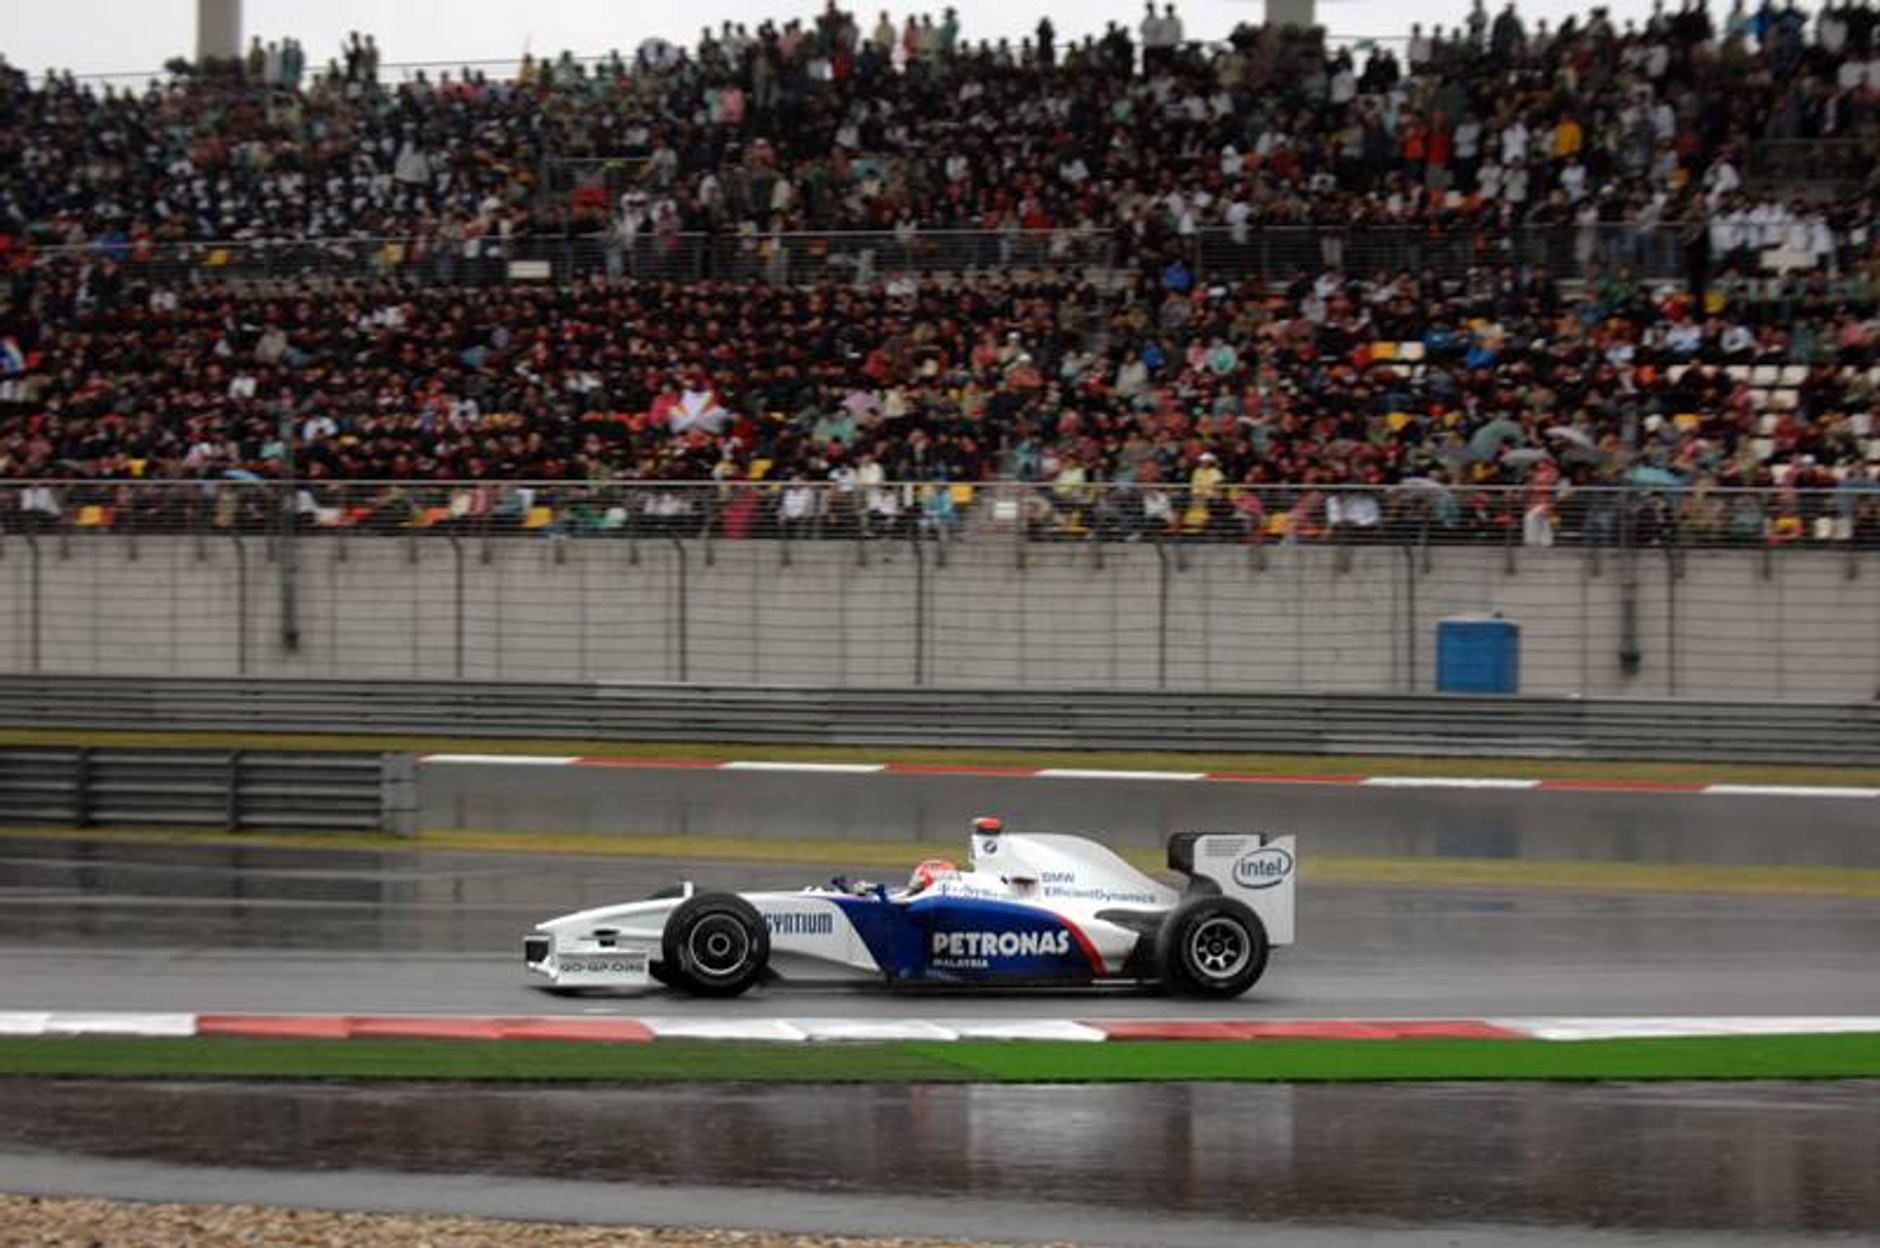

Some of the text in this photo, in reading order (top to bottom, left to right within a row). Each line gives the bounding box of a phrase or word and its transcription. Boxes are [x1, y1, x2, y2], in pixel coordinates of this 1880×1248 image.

[1240, 857, 1282, 876] intel
[1041, 872, 1075, 883] BMW
[933, 930, 1069, 956] PETRONAS
